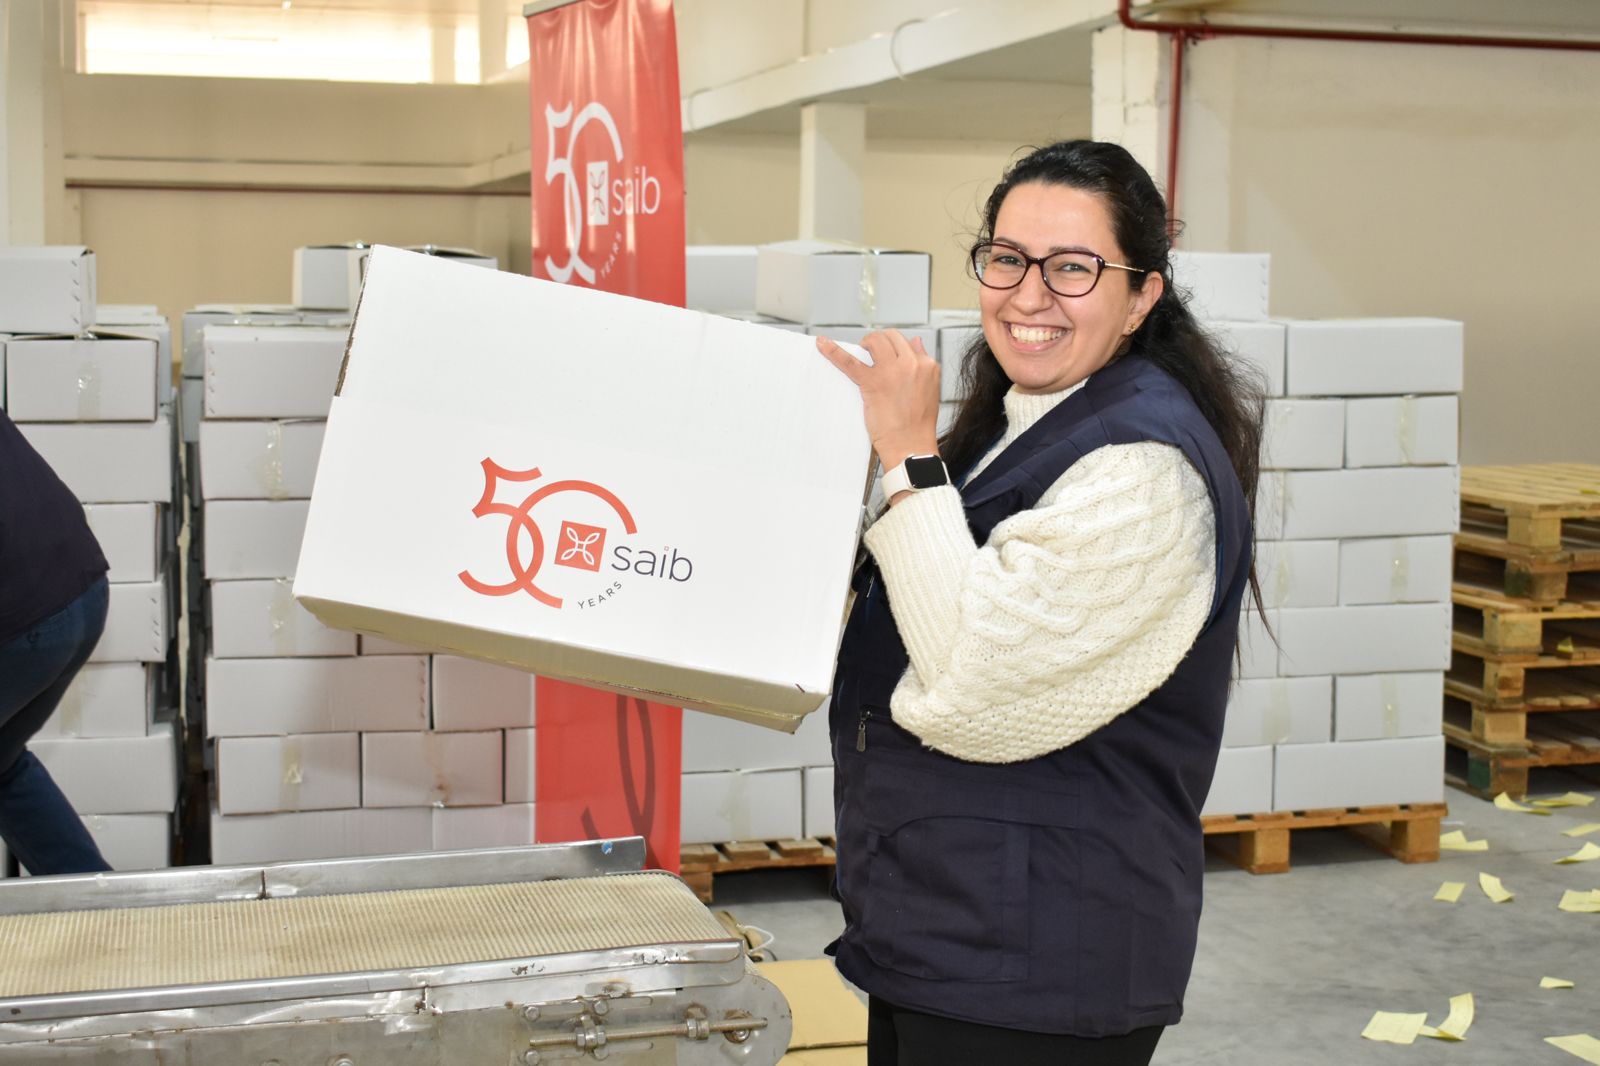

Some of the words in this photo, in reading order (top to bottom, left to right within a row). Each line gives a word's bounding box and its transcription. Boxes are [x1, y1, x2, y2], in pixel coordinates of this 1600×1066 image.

[545, 102, 623, 284] 50
[612, 166, 660, 215] saib
[458, 456, 638, 609] 50
[611, 545, 693, 582] saib
[577, 580, 622, 610] YEARS
